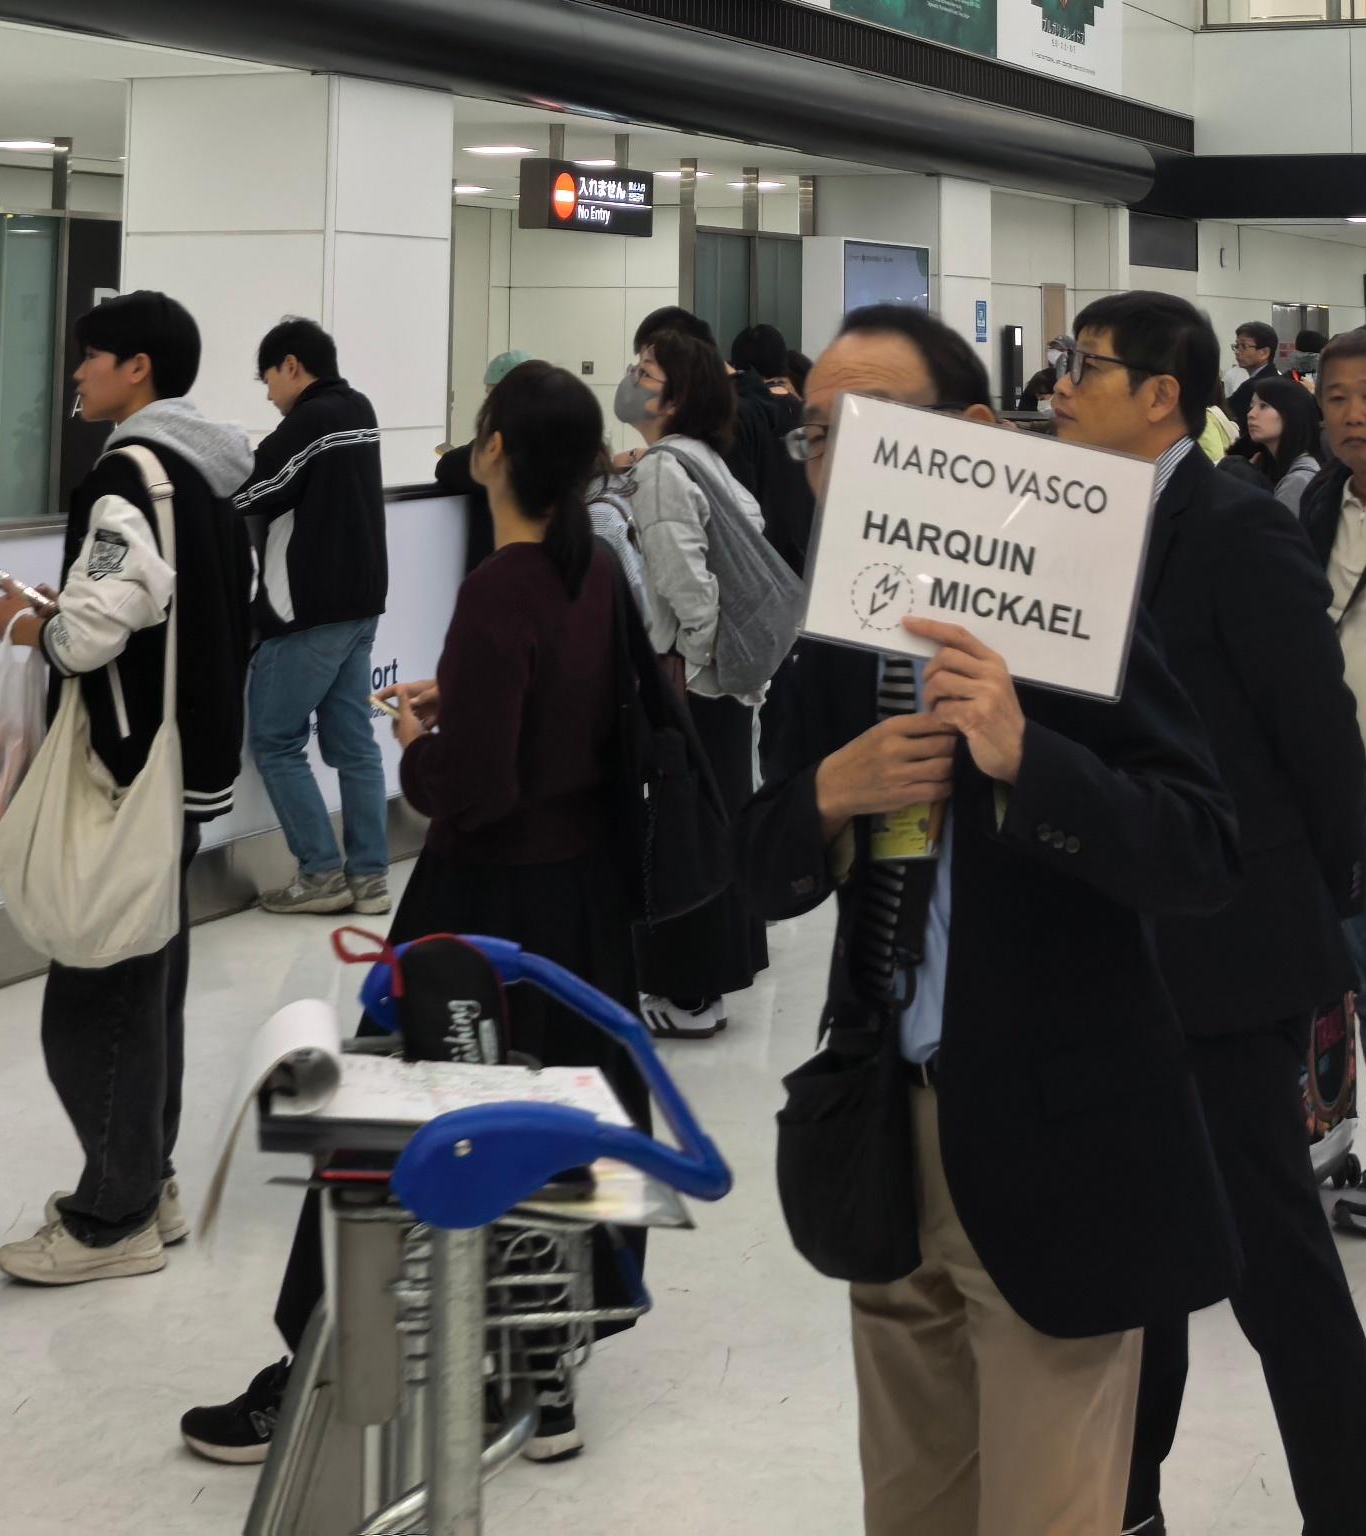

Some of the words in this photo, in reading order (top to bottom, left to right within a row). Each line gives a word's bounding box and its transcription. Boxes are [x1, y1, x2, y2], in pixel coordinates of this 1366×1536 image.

[577, 205, 589, 219] No
[591, 206, 610, 225] Entry
[873, 437, 995, 489] MARCO
[1004, 464, 1107, 515] VASCO
[862, 510, 1036, 576] HARQUIN
[929, 577, 1092, 641] MICKAEL
